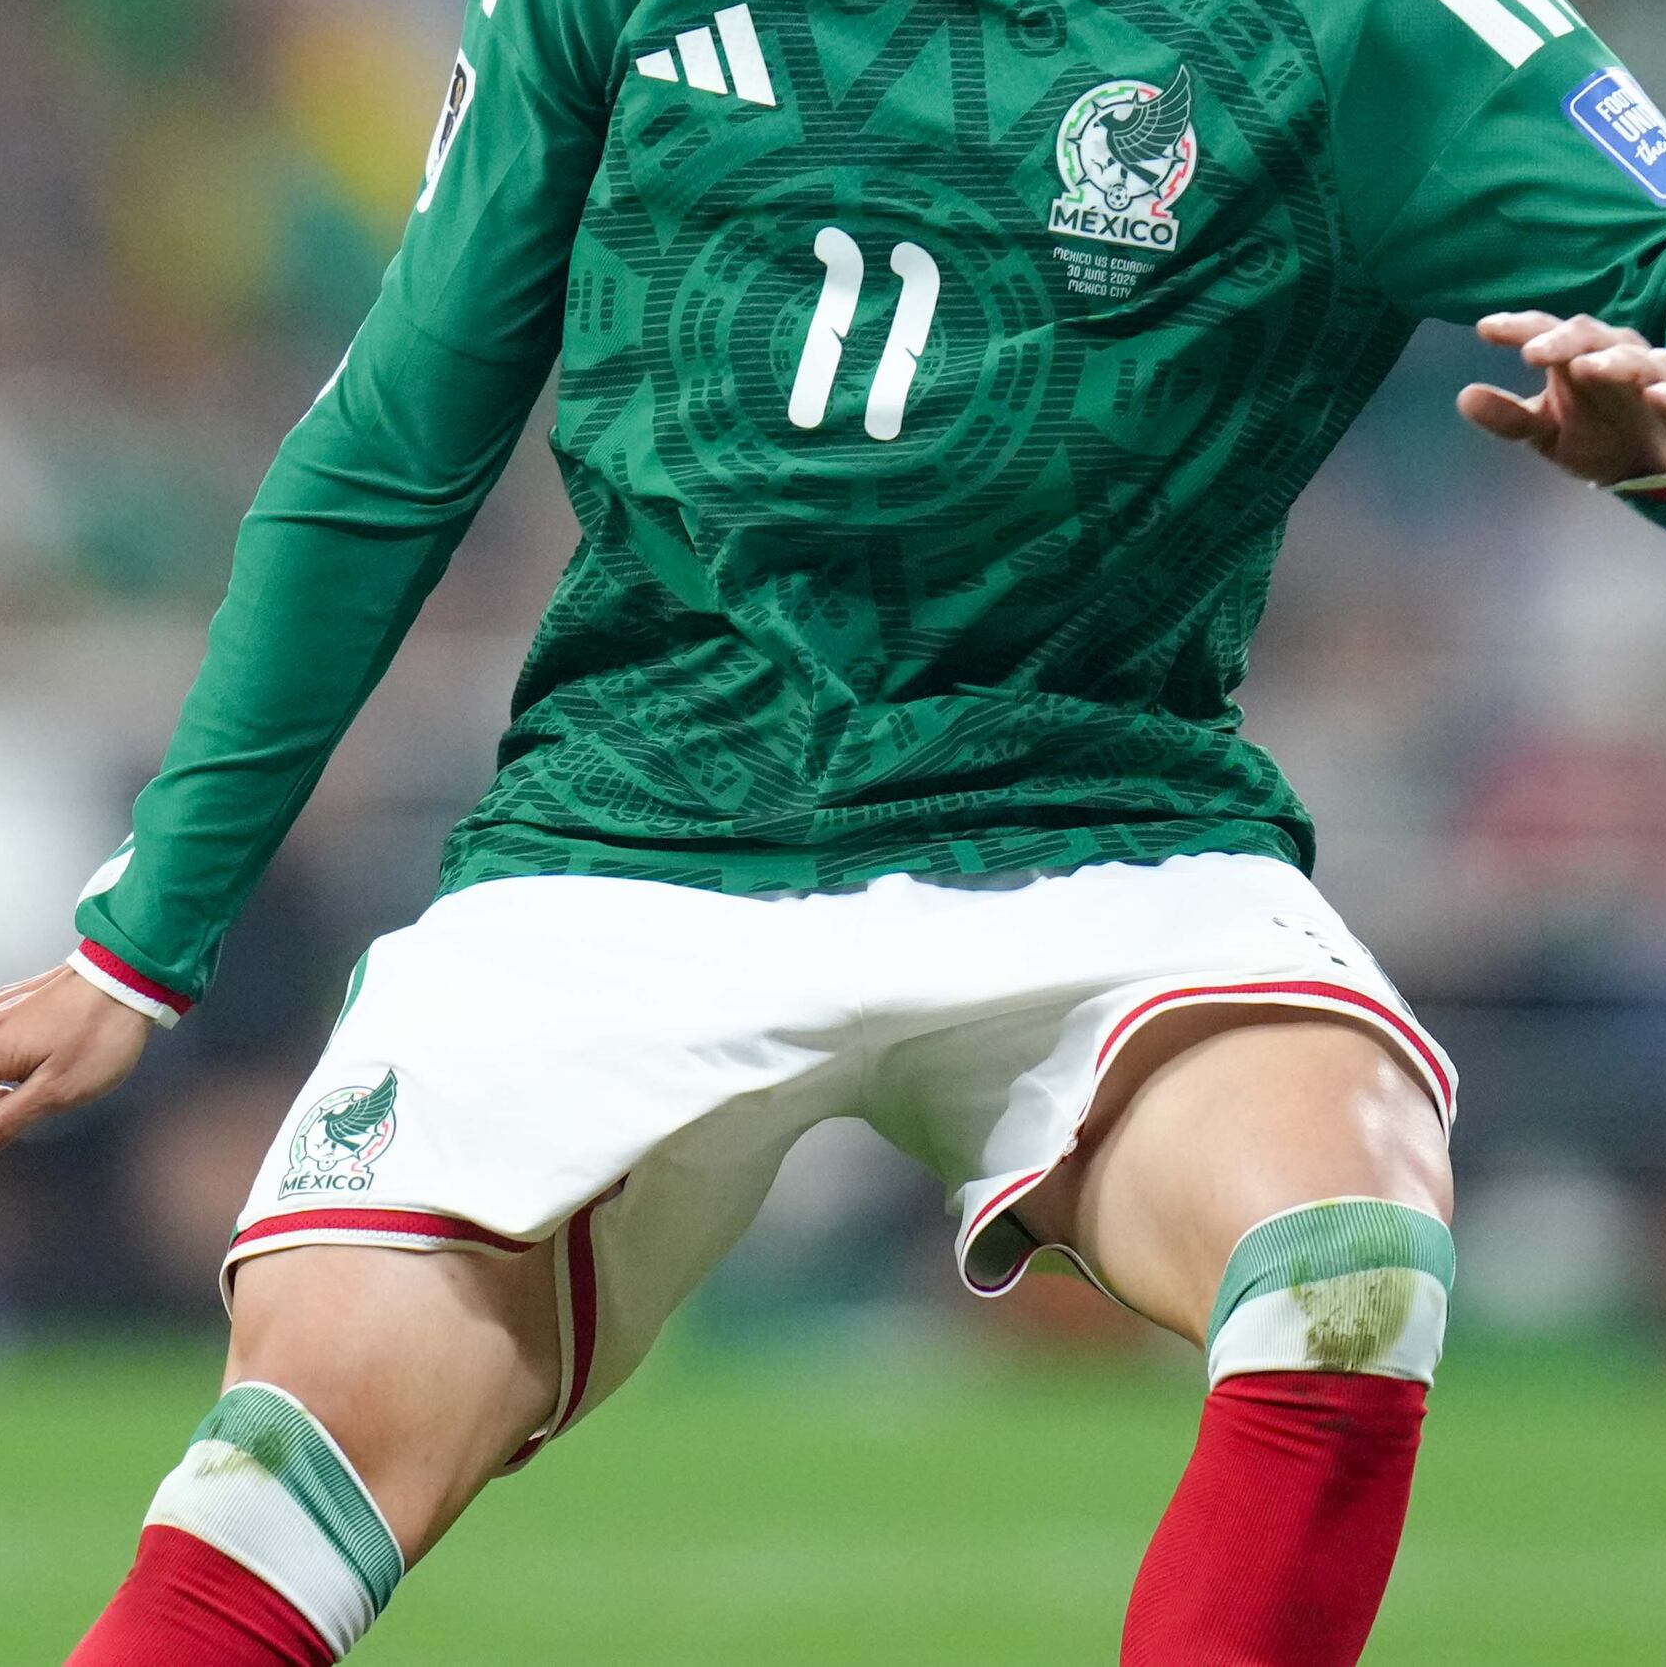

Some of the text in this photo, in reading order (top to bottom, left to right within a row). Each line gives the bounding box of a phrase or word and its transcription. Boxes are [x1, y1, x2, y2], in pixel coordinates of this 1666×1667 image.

[1052, 205, 1173, 245] MÉXICO
[1053, 246, 1092, 265] MEXICO
[1110, 257, 1155, 274] ECUADOR
[1066, 264, 1137, 287] 30 JUNE 2026
[1067, 279, 1132, 299] MEXICO CITY
[787, 226, 940, 441] 11
[282, 1171, 366, 1194] MÉXICO
